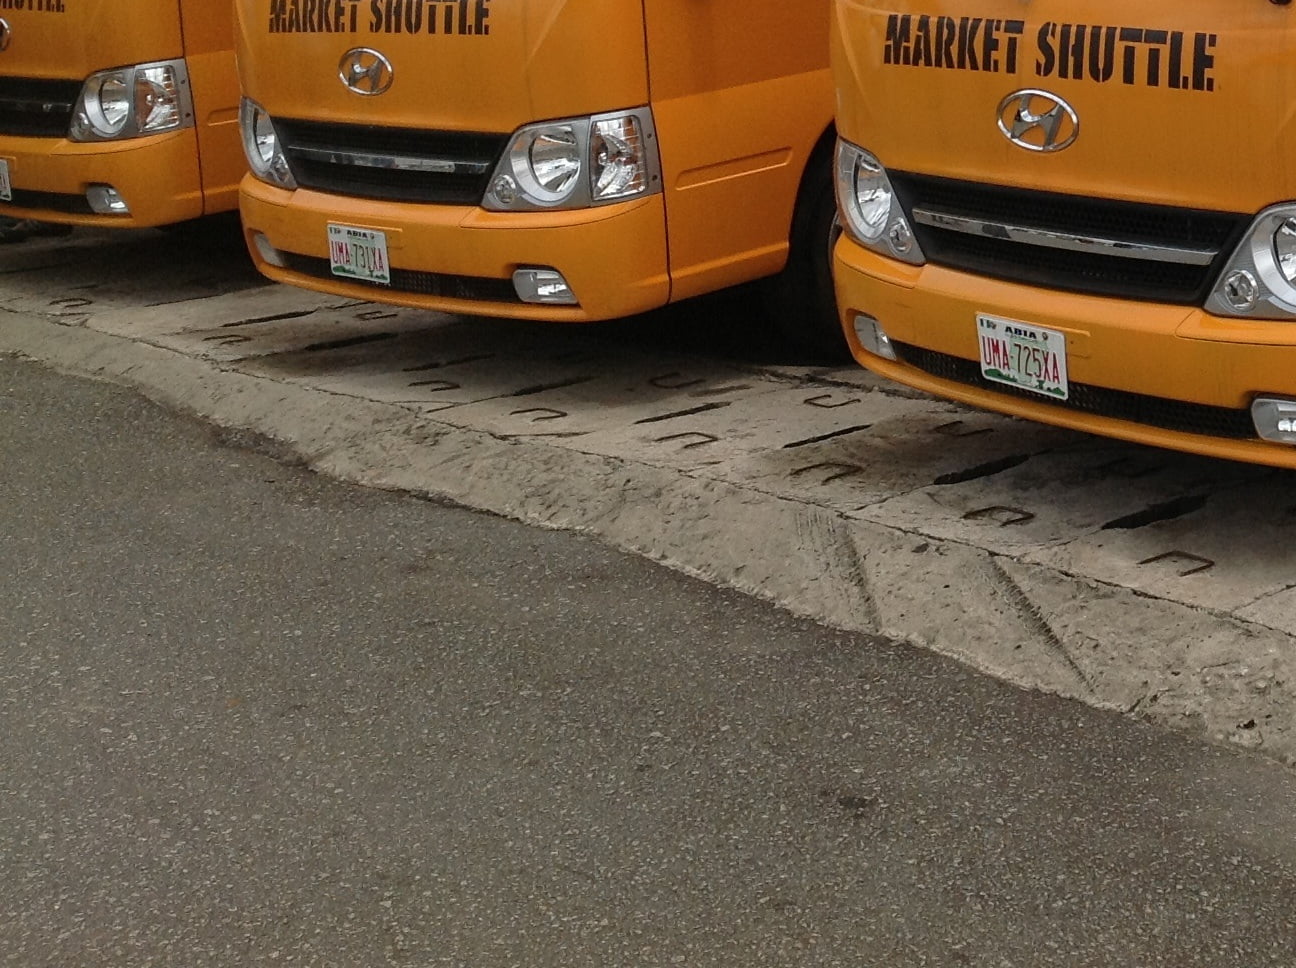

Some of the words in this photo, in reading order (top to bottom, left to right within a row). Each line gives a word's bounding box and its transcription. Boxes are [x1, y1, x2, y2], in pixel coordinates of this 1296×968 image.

[884, 14, 1024, 74] MARKET
[1035, 21, 1217, 92] SHUTTLE
[1005, 325, 1037, 340] ABIA
